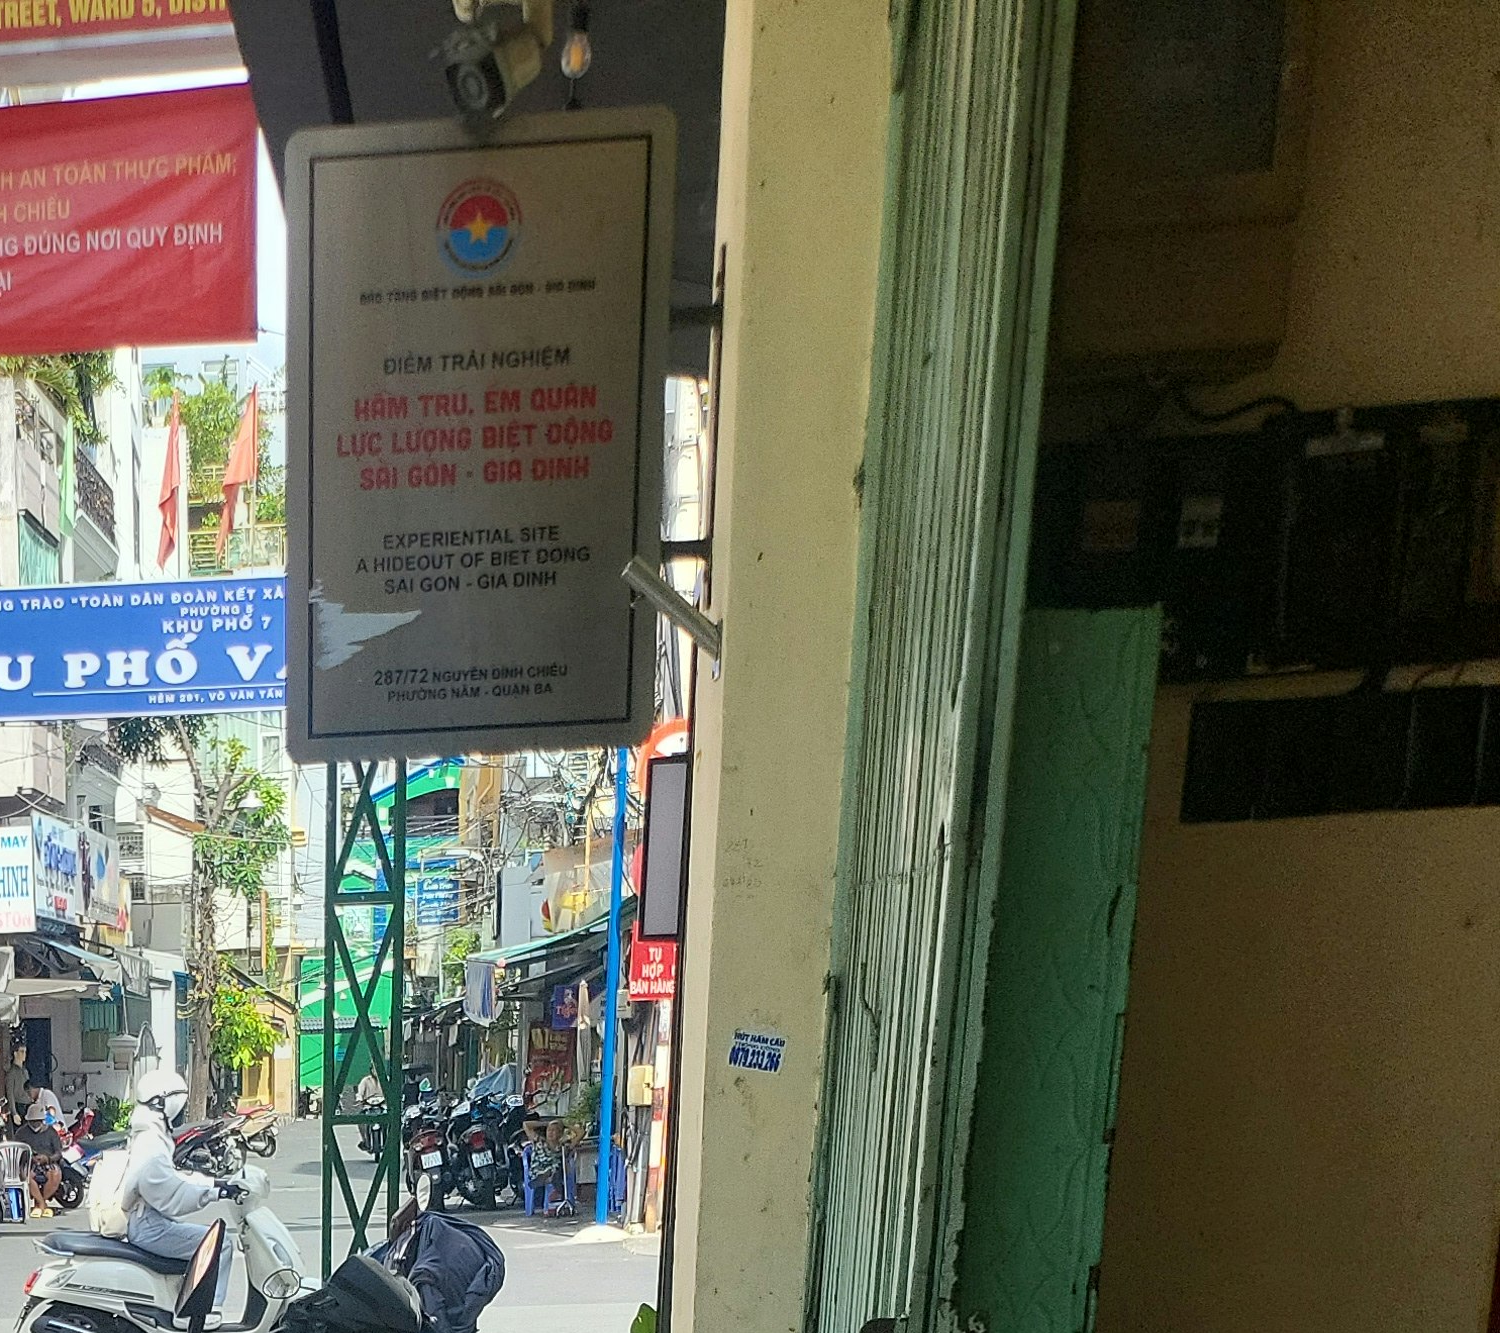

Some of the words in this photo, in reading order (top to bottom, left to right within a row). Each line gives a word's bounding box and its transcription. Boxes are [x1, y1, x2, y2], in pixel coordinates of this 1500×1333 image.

[69, 0, 134, 22] WARD
[23, 228, 80, 254] ĐÚNG
[87, 229, 120, 251] NƠI
[126, 225, 168, 248] QUY
[174, 223, 222, 249] ĐỊNH
[384, 528, 516, 549] EXPERIENTIAL
[521, 525, 559, 542] SITE
[356, 558, 368, 573] A
[374, 553, 455, 572] HIDEOUT
[460, 552, 483, 568] OF
[491, 549, 531, 566] BIET
[537, 546, 590, 564] DONG
[385, 578, 414, 594] SAI
[420, 576, 460, 592] GON
[477, 573, 508, 589] GIA
[514, 571, 557, 587] DINH
[21, 596, 64, 609] TRÀO
[131, 592, 163, 605] DÂN
[171, 590, 217, 606] ĐOÀN
[225, 587, 255, 601] KẾT
[162, 620, 203, 634] KHU
[212, 614, 253, 632] PHỐ
[261, 616, 273, 630] 7
[62, 632, 199, 689] PHỐ
[225, 645, 286, 681] V
[1, 836, 28, 847] MAY
